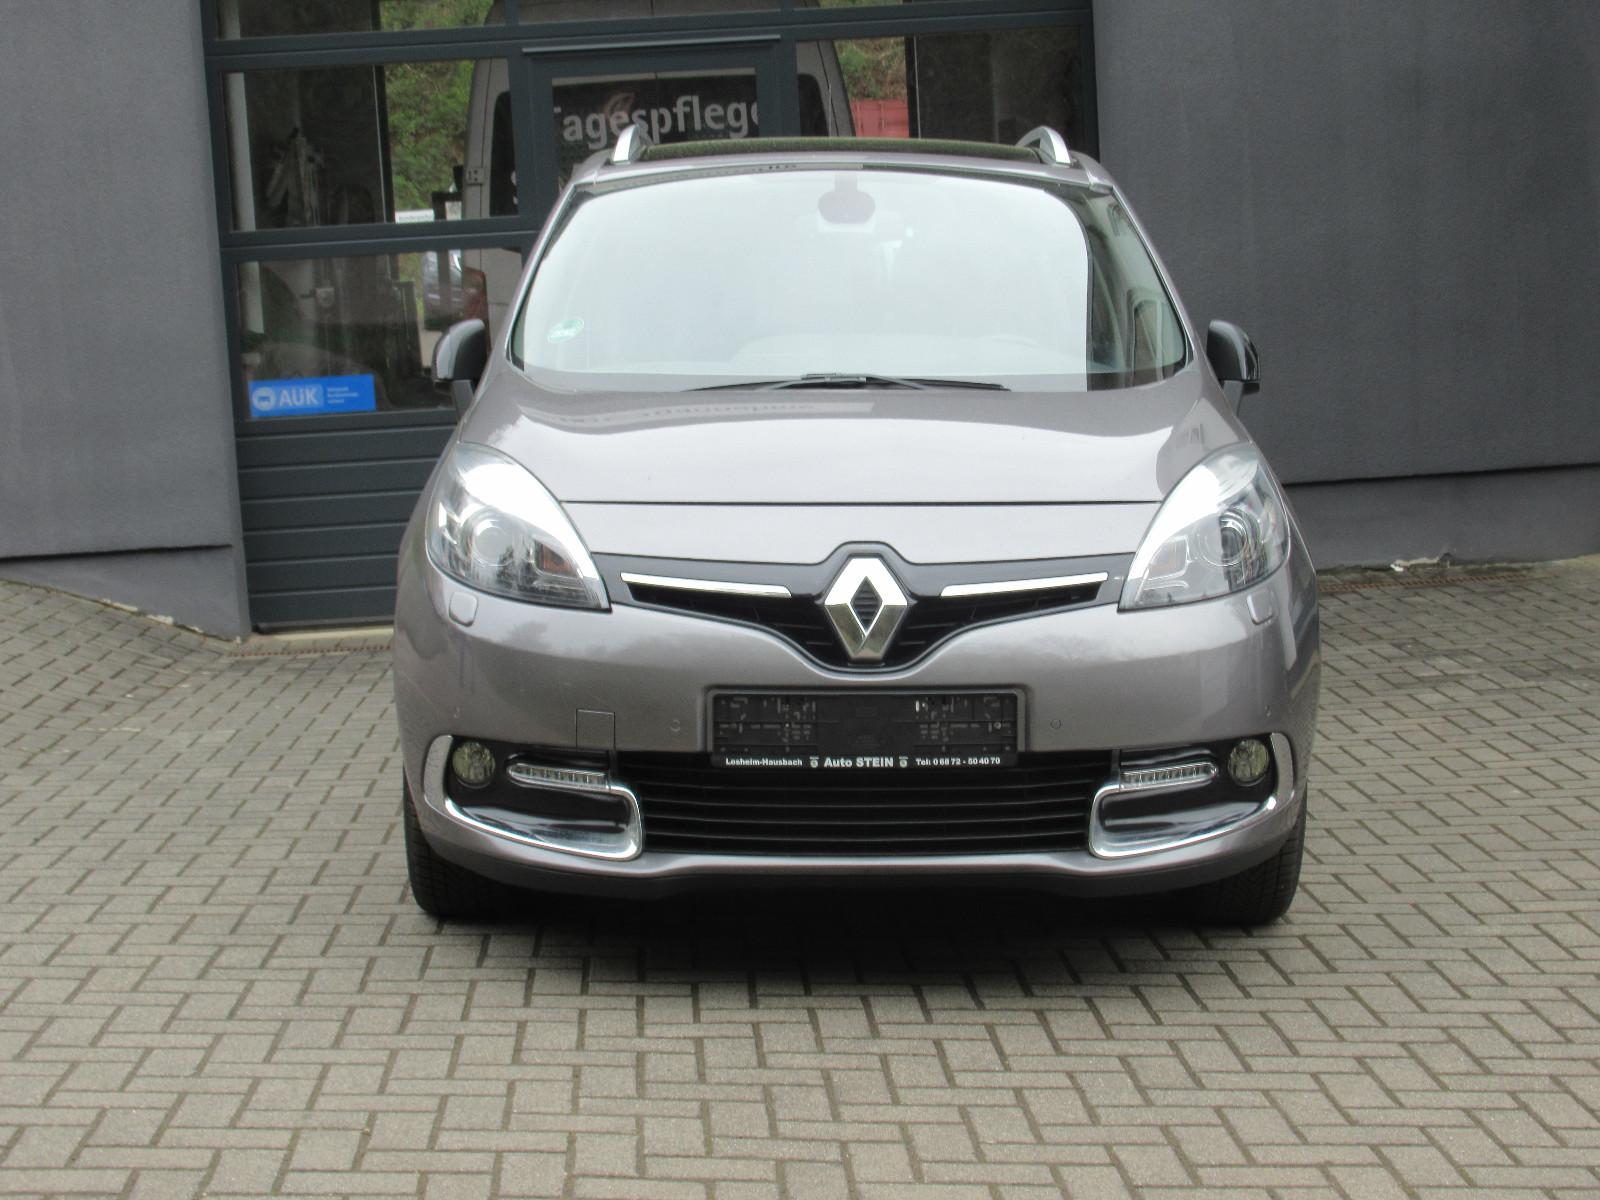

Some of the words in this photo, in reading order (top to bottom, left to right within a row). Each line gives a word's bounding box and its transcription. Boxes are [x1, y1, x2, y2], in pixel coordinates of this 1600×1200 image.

[553, 95, 758, 150] agespfleg
[280, 386, 319, 407] AUK
[824, 757, 853, 768] Auto
[856, 757, 894, 768] STEIN
